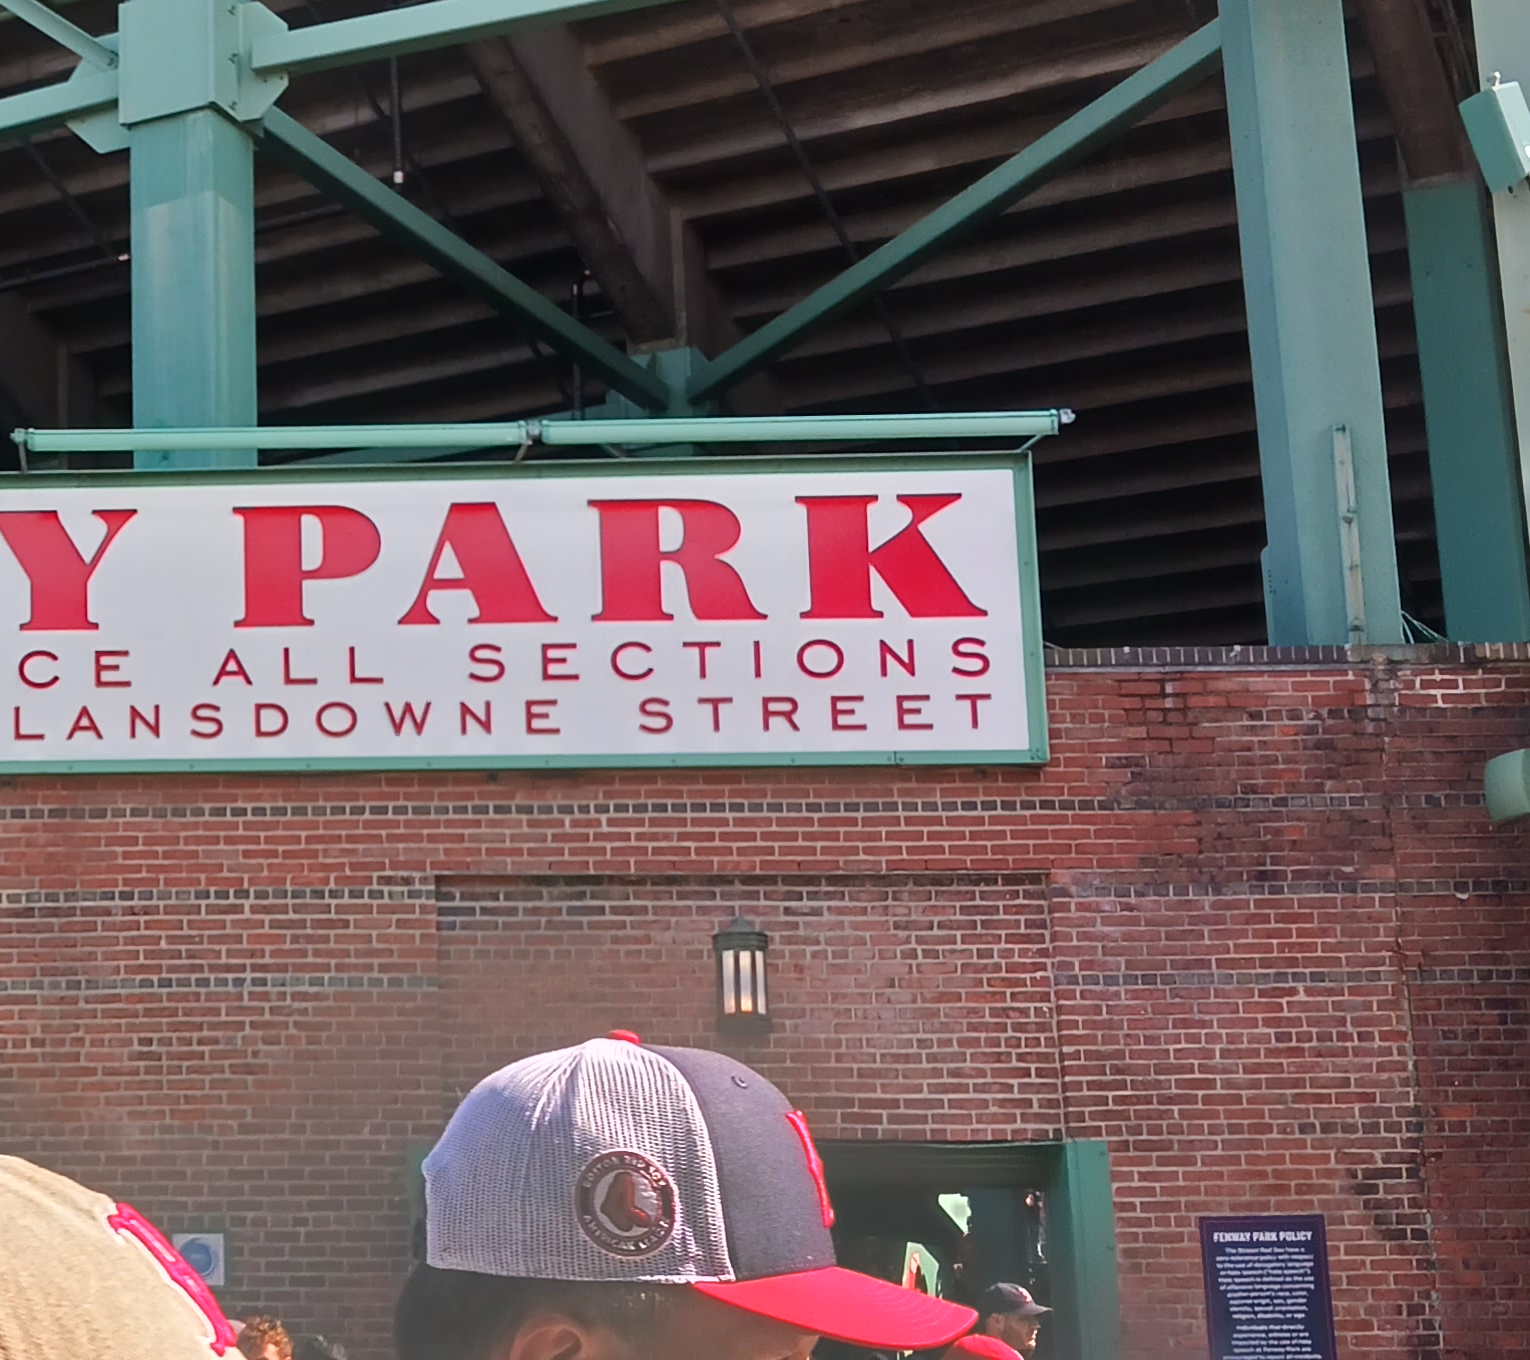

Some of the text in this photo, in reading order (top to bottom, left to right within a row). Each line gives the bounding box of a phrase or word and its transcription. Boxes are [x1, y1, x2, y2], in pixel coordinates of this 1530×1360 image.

[232, 494, 988, 631] PARK
[213, 646, 384, 687] ALL
[468, 637, 991, 685] SECTIONS
[13, 699, 560, 741] LANSDOWNE
[639, 693, 991, 735] STREET
[1278, 1230, 1313, 1242] POLICY
